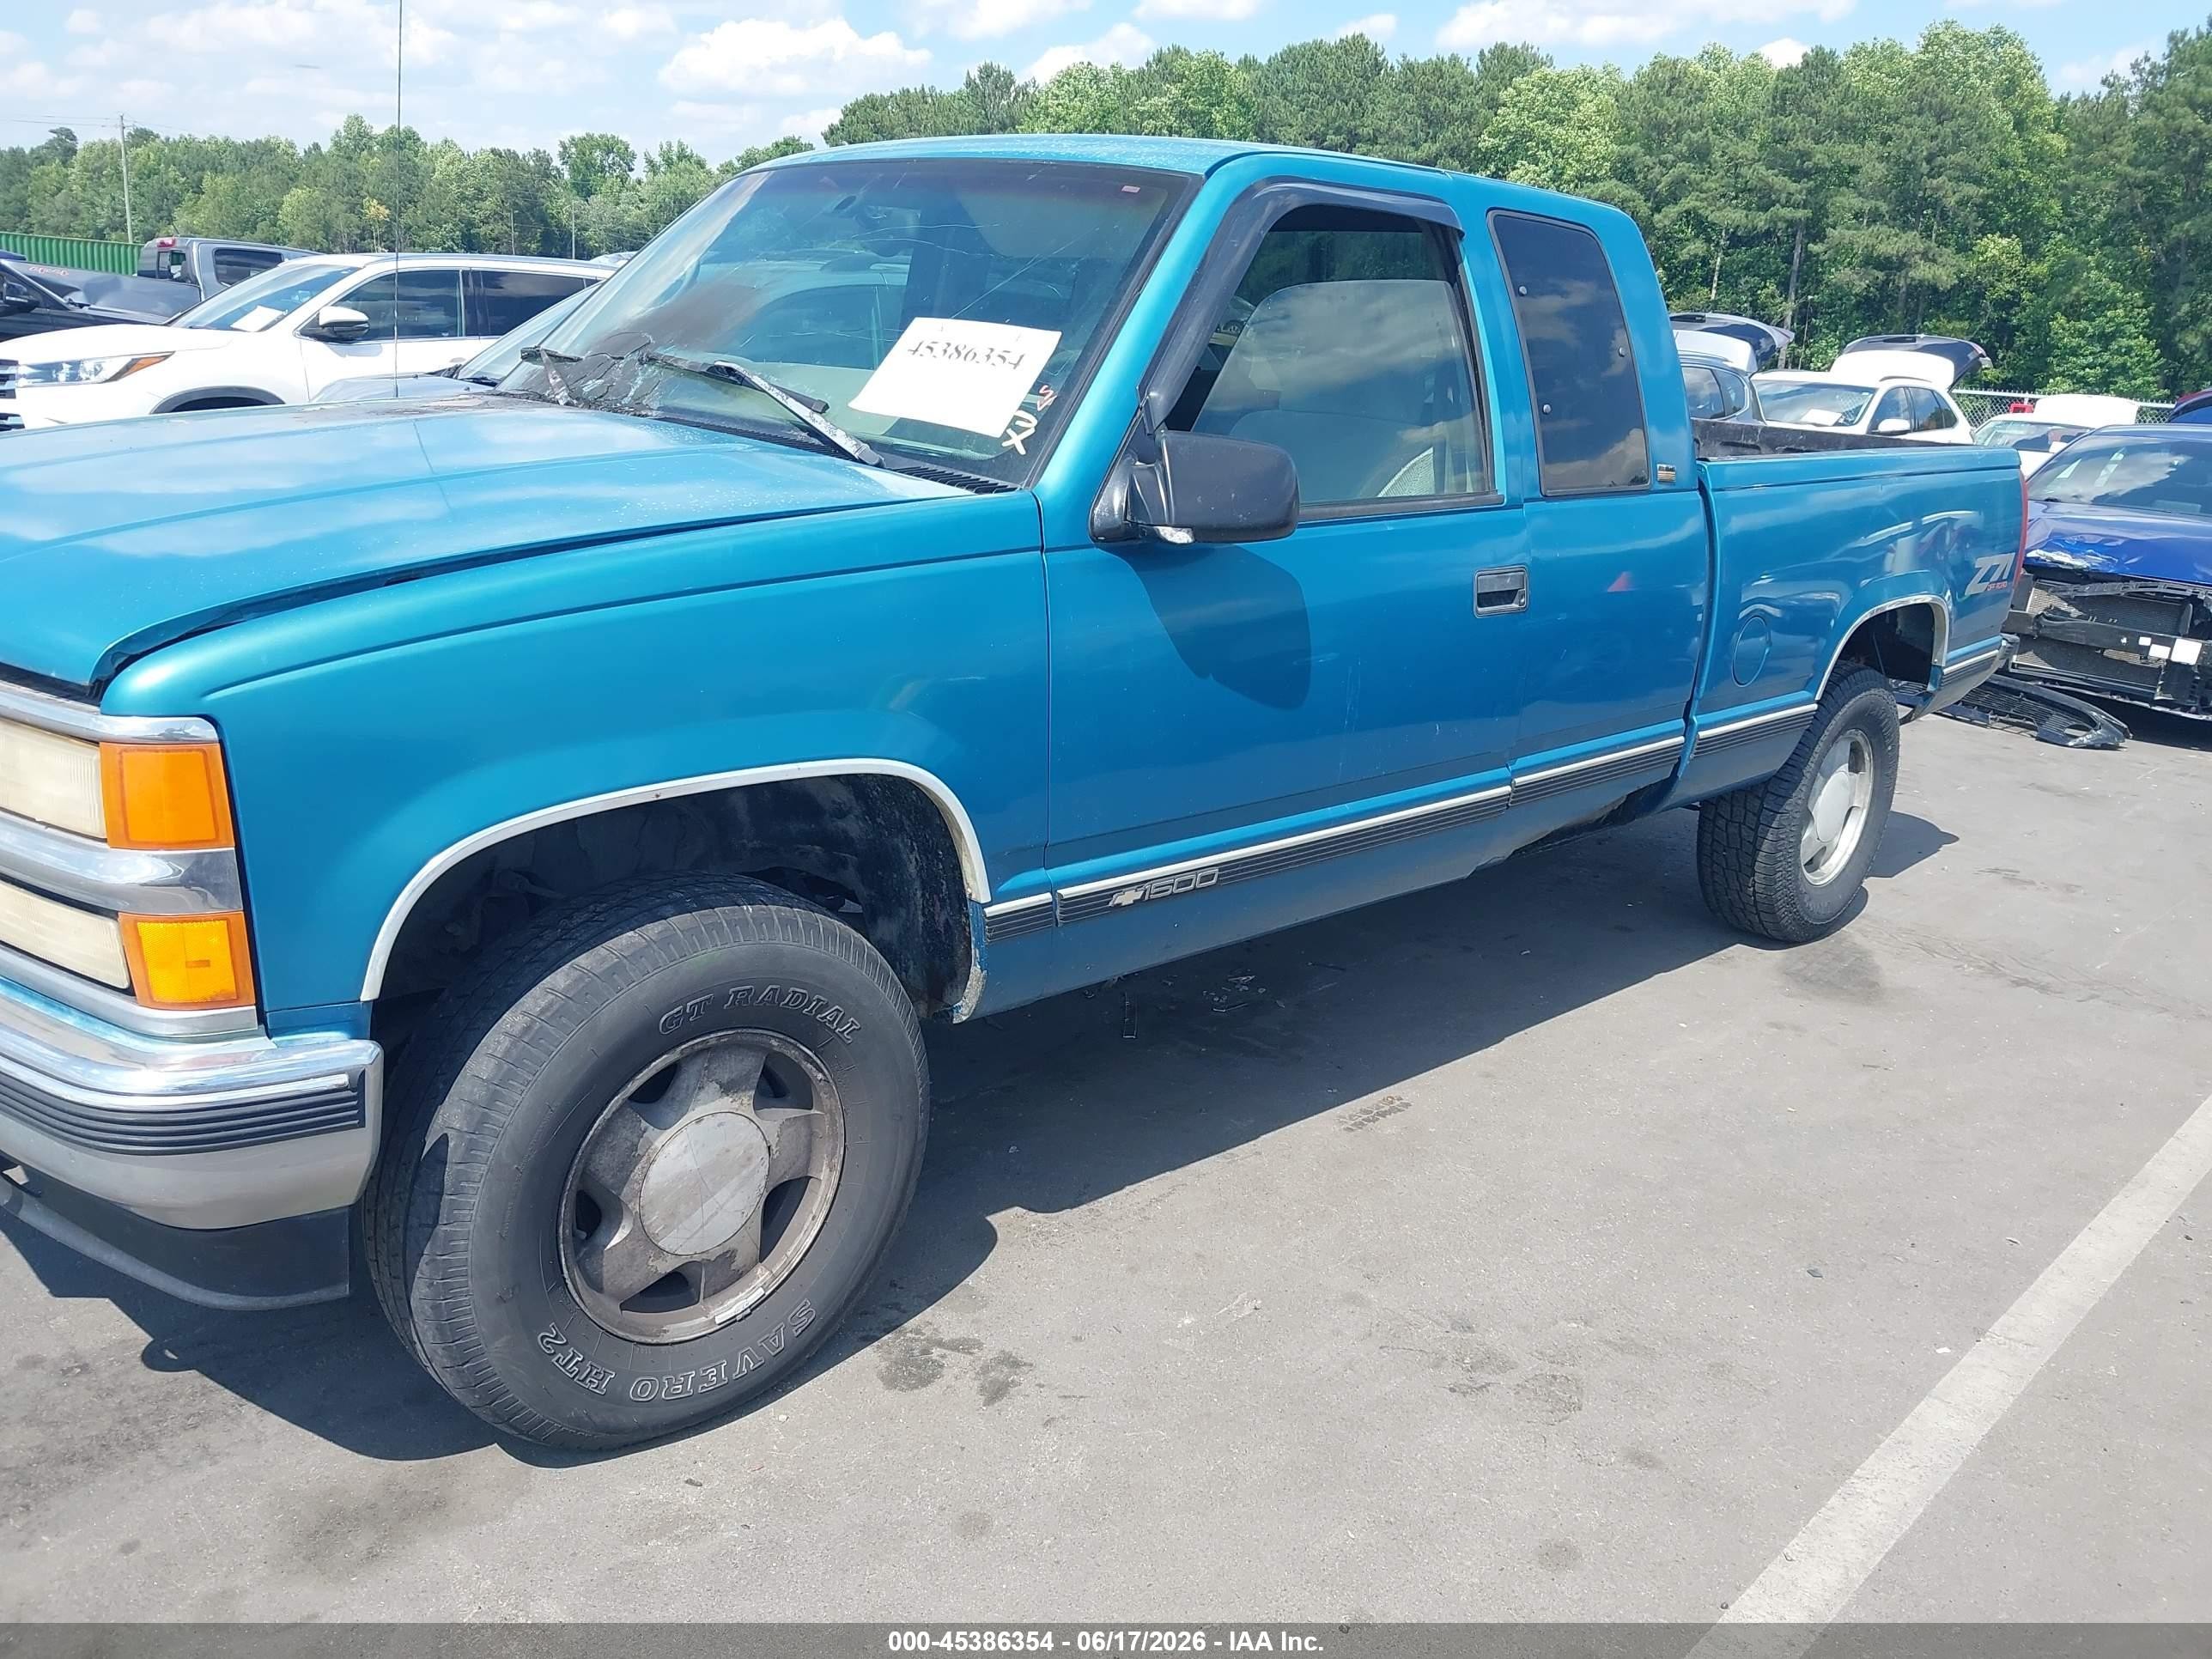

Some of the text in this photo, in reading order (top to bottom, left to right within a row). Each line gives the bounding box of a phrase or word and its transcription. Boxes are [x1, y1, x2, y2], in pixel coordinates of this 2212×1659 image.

[907, 340, 1026, 370] 45386354
[1964, 552, 2015, 596] Z71
[1143, 866, 1219, 902] 1500
[659, 984, 861, 1045] GT RADIAL
[536, 1297, 817, 1402] SAVERO HT2
